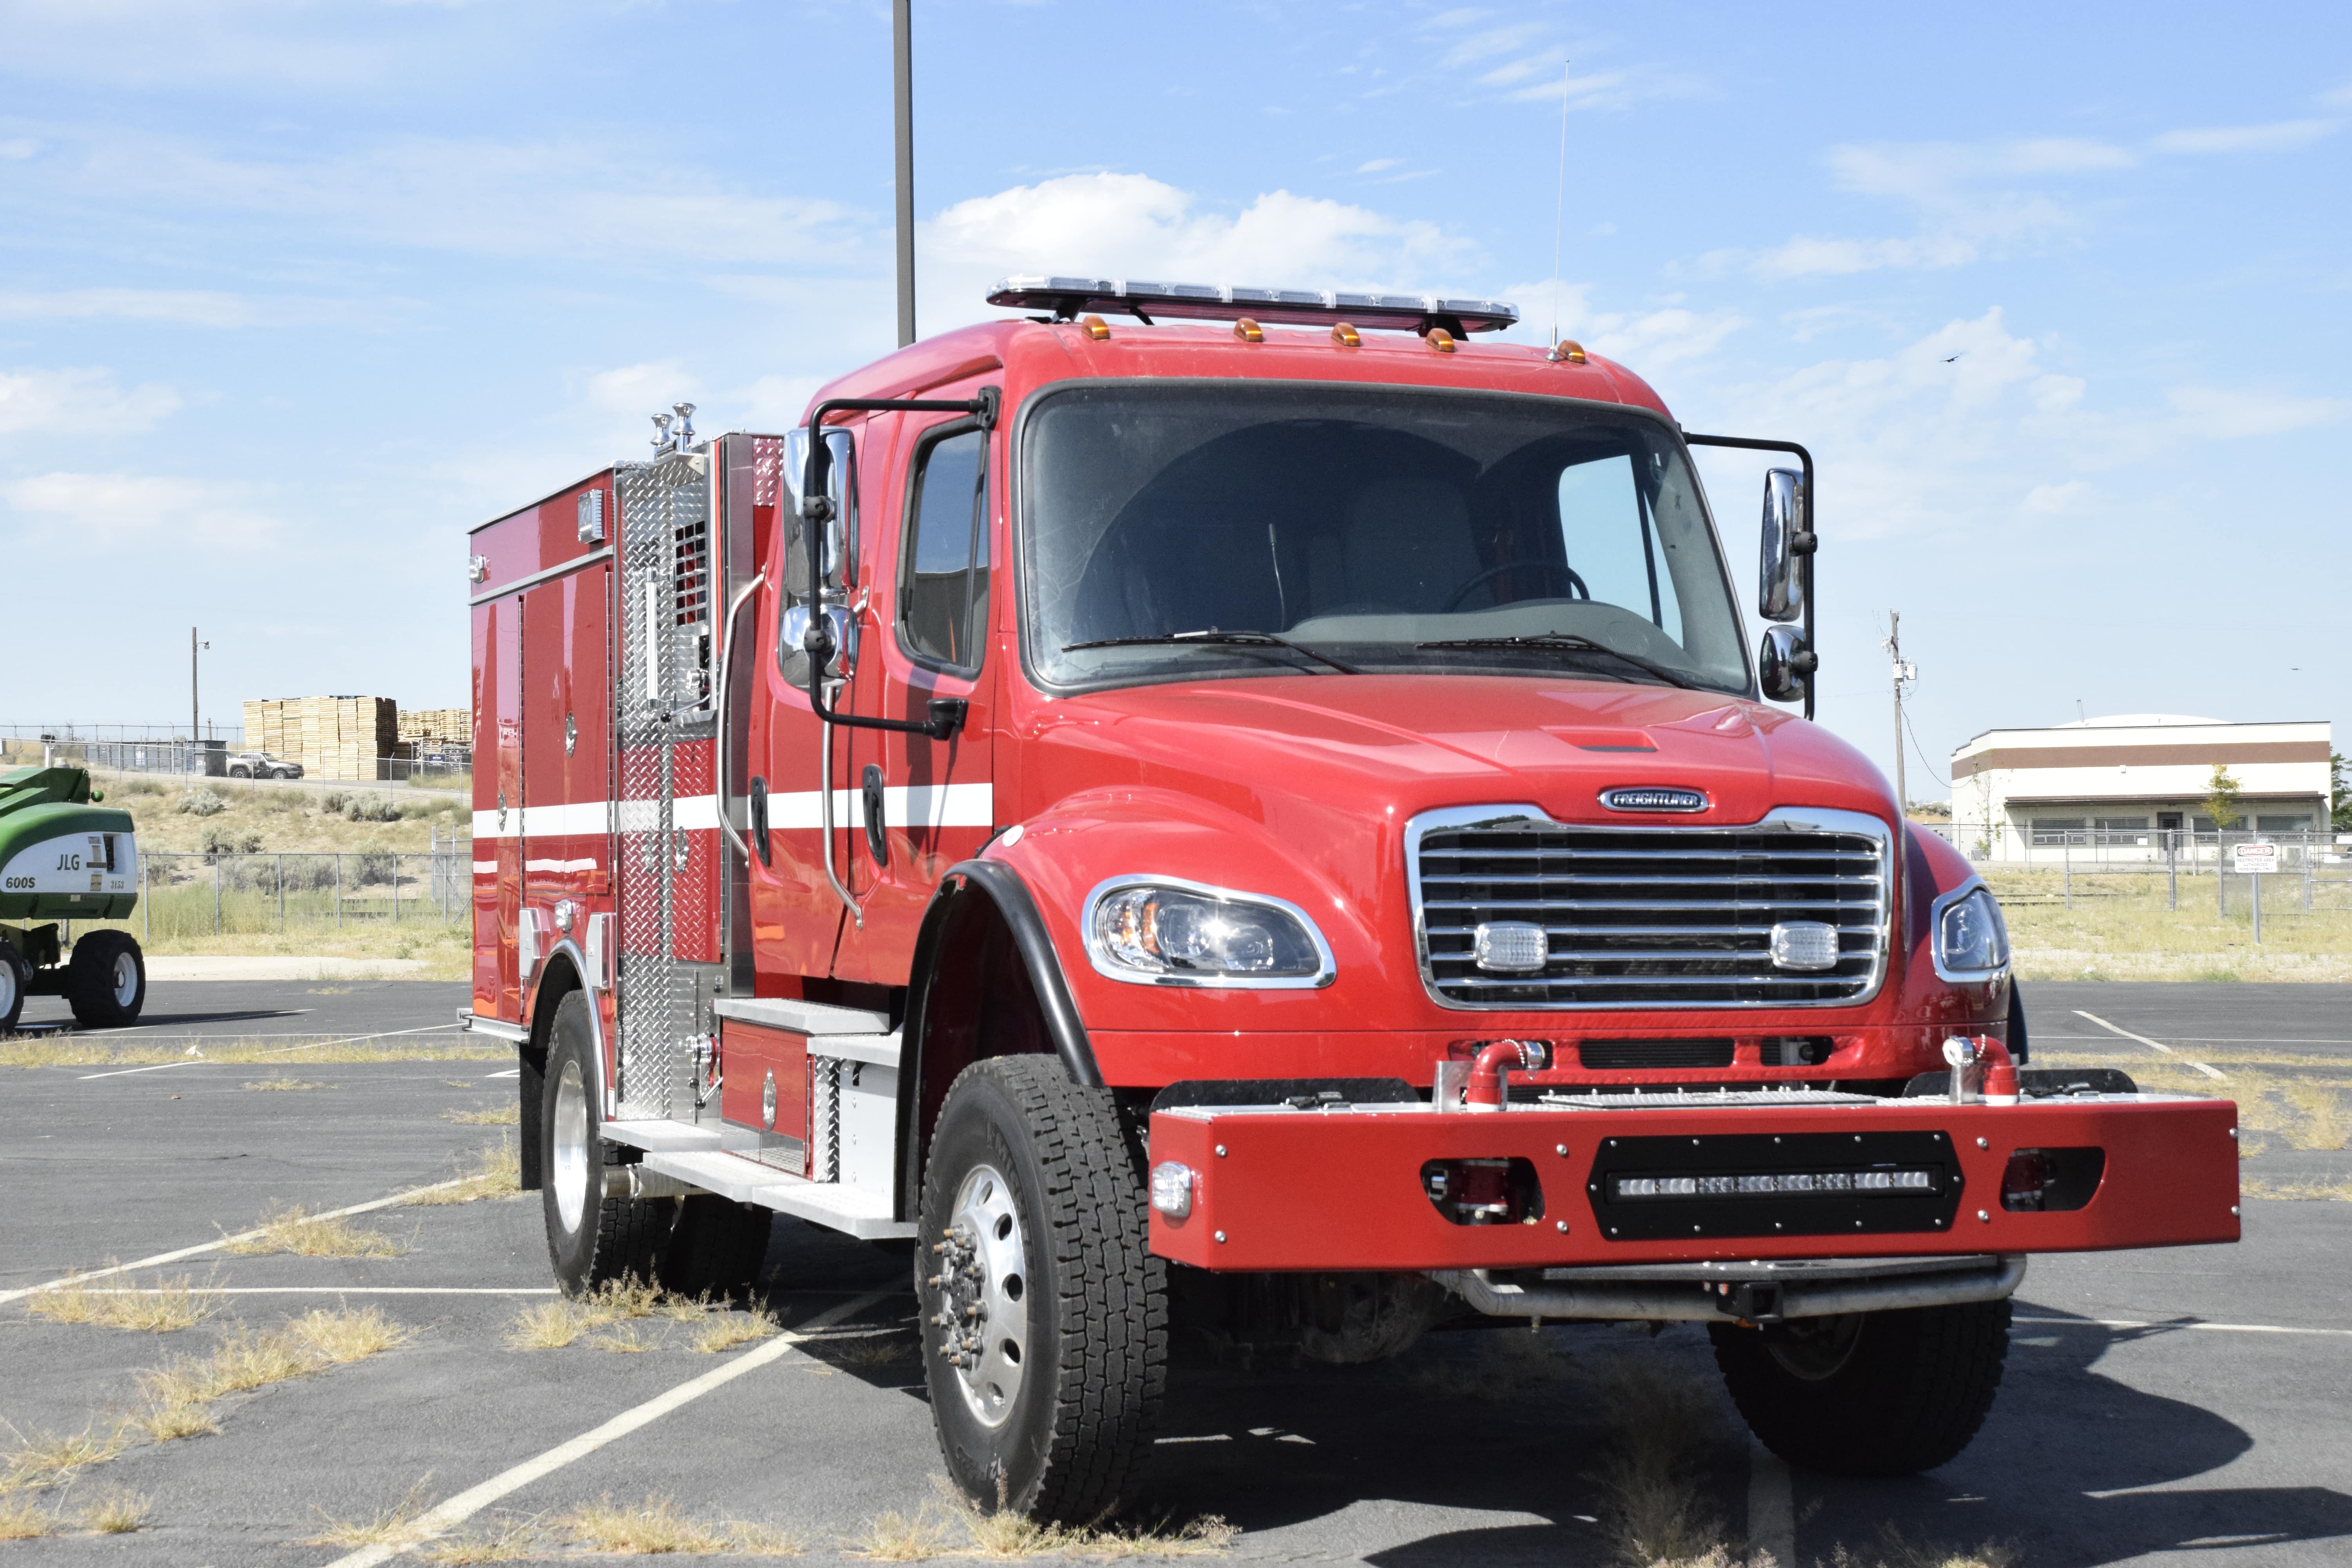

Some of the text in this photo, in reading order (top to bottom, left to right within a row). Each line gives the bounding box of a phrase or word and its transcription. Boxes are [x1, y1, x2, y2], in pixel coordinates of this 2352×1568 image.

[1614, 793, 1698, 805] FREIGHTLINER
[57, 854, 80, 871] JLG
[6, 877, 36, 889] 600S
[111, 880, 124, 889] 3153
